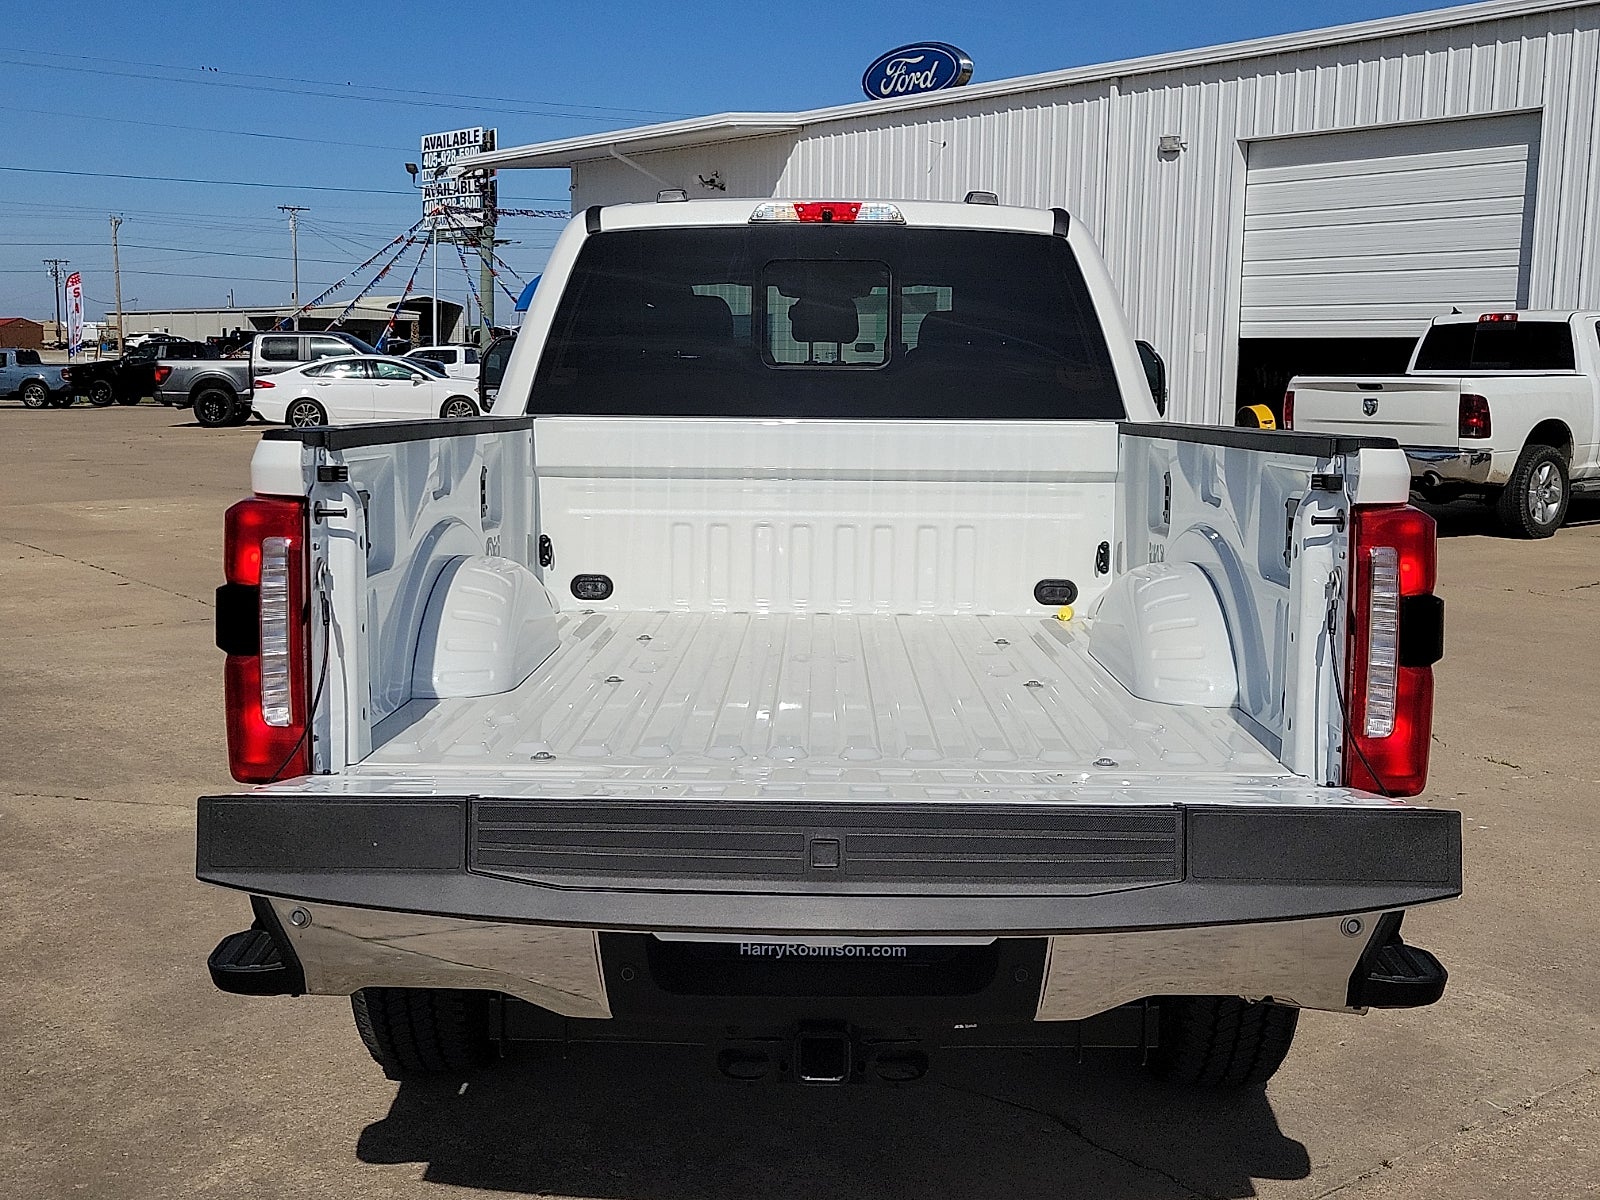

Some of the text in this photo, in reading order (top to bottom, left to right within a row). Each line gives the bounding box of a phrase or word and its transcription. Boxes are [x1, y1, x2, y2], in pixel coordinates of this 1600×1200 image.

[880, 55, 939, 95] Ford
[423, 129, 480, 151] AVAILABLE
[423, 146, 480, 168] 405-9285800
[424, 180, 480, 199] AVAILABLE
[740, 943, 907, 958] HarryRobinson.com
